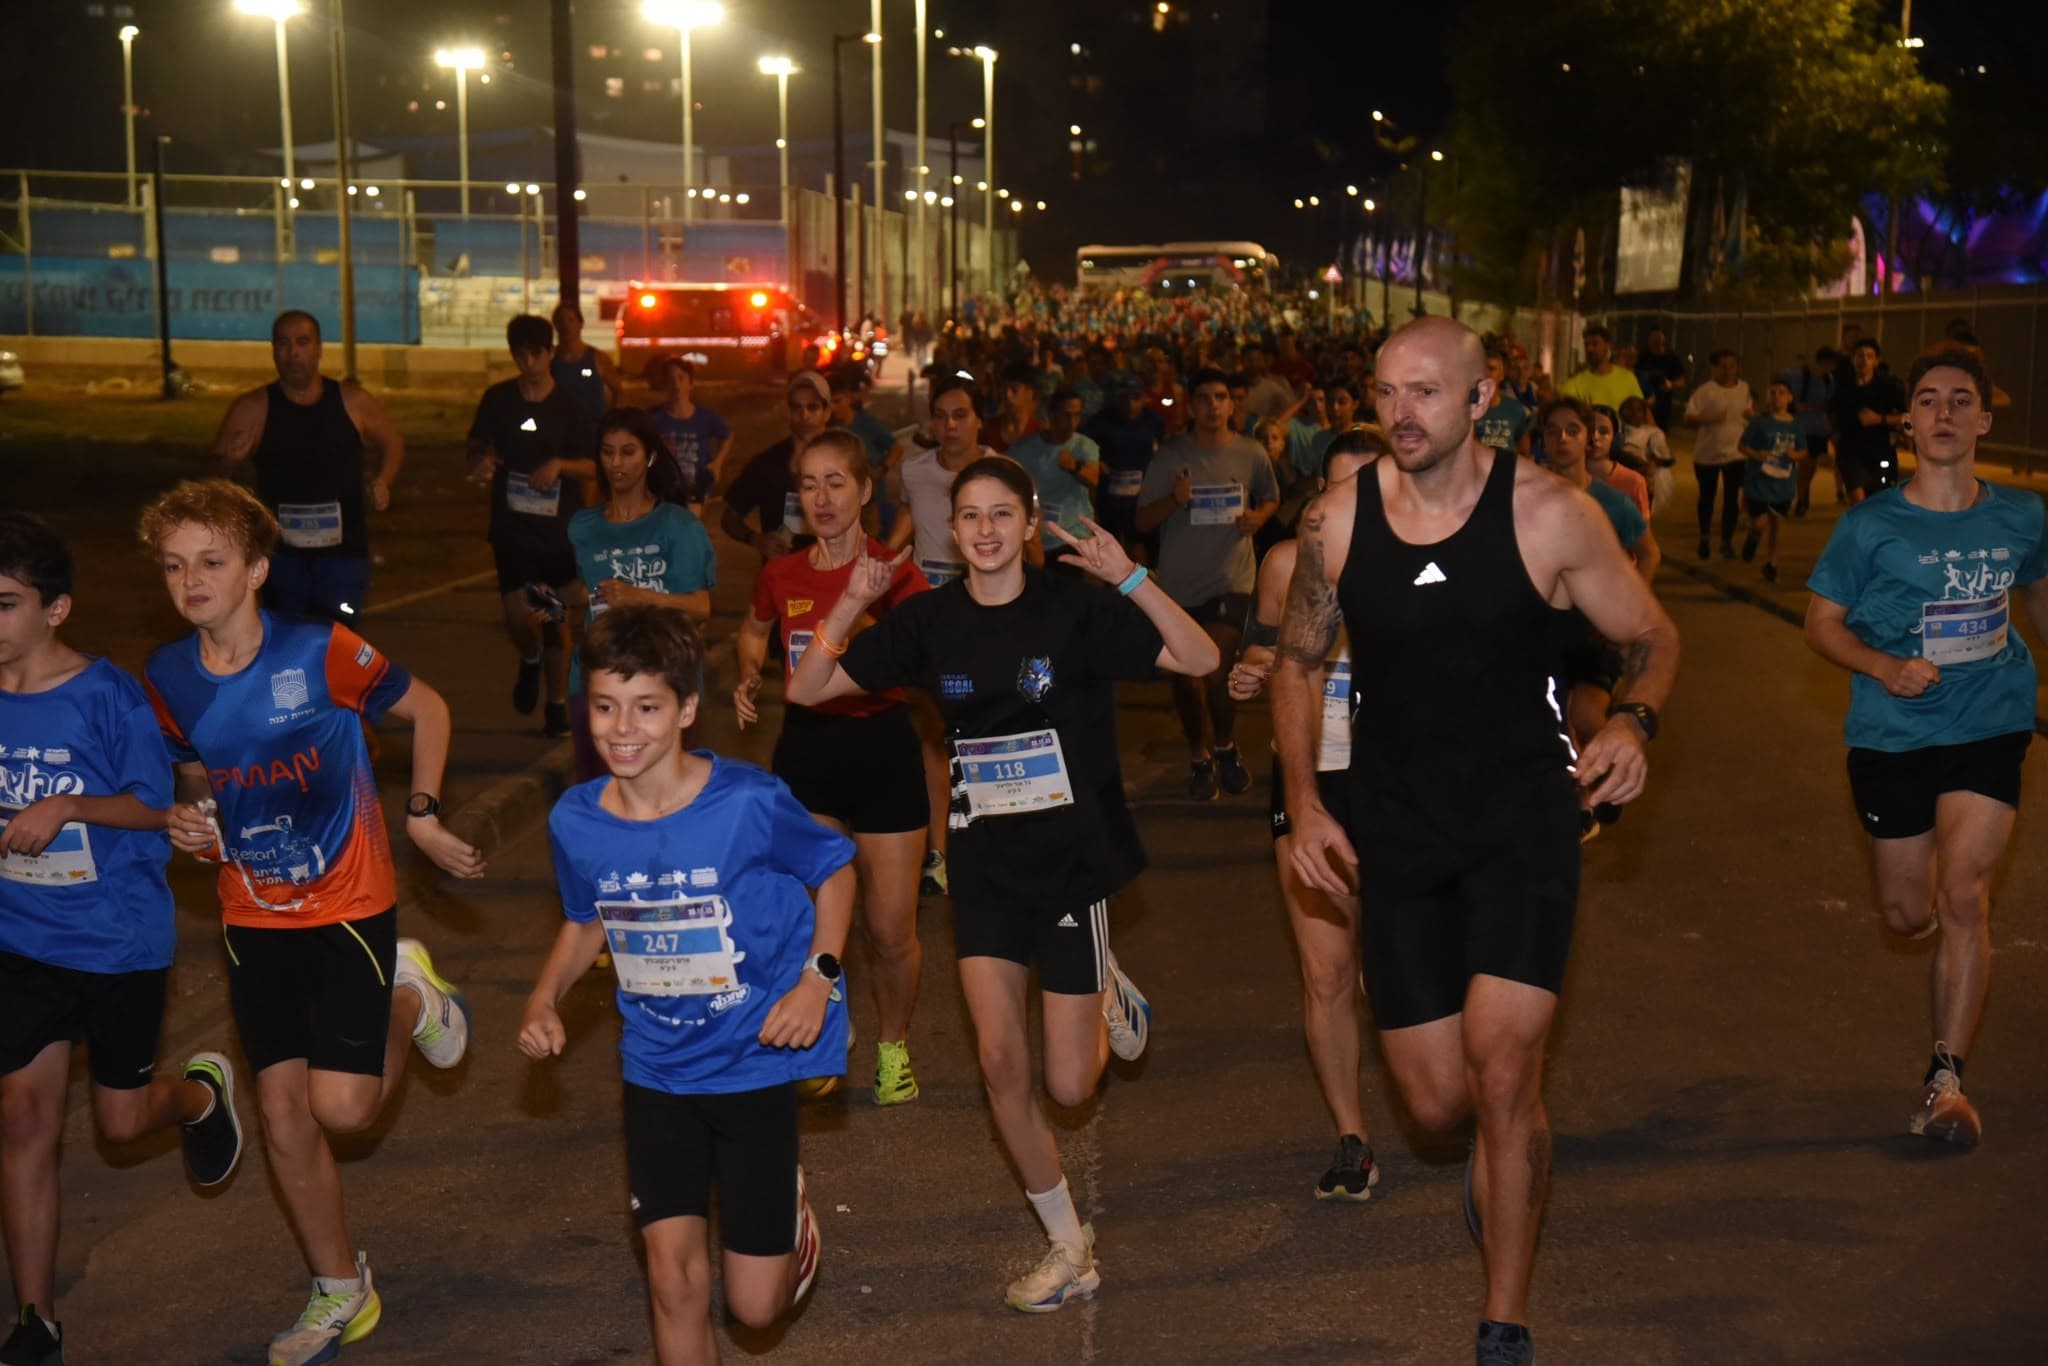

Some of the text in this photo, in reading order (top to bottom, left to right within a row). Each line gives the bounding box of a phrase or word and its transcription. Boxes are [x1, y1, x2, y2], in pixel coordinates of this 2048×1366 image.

[1958, 619, 1987, 635] 434
[1323, 681, 1336, 695] 9
[994, 761, 1026, 779] 118
[643, 934, 678, 953] 247
